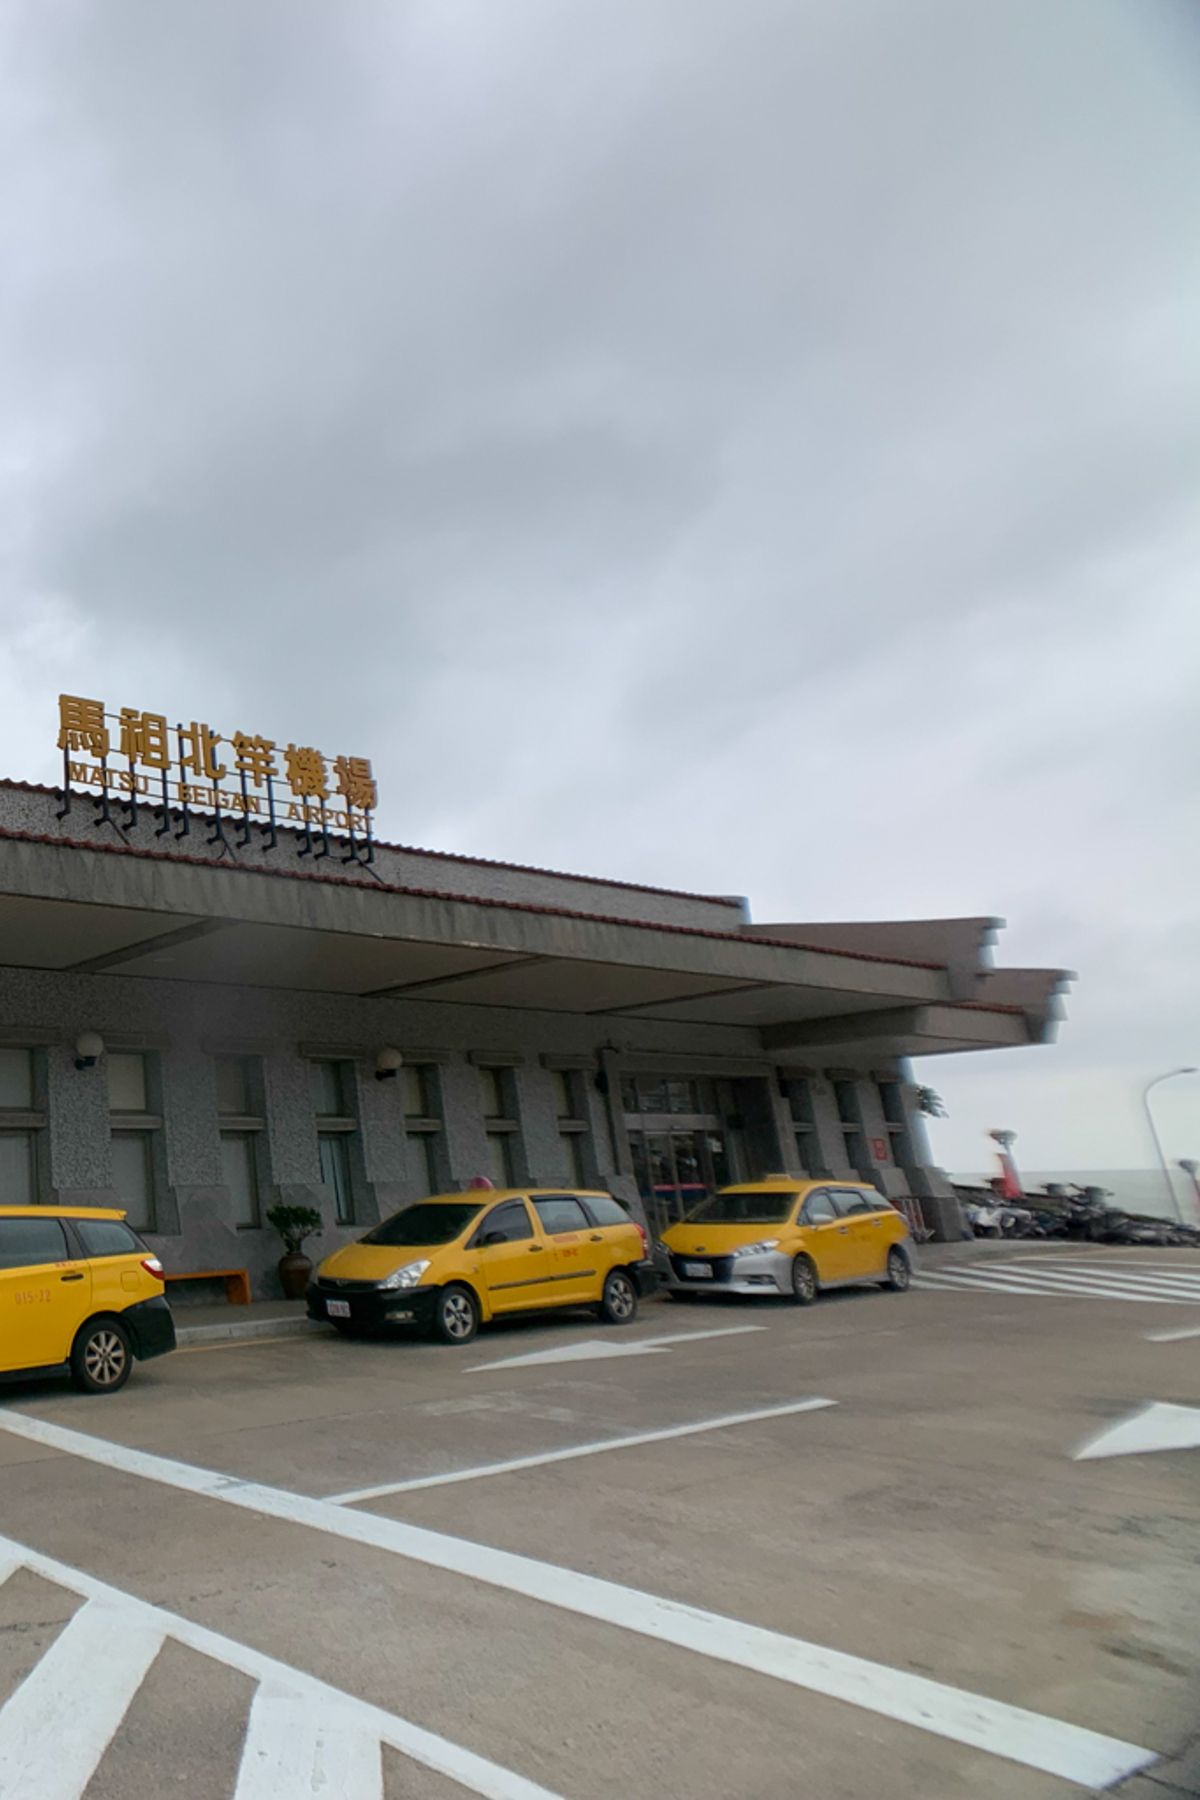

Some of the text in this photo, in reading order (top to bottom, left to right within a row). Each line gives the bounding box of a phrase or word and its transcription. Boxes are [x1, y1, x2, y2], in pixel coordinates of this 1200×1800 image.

[57, 693, 378, 810] 馬祖北竿機場
[69, 760, 375, 833] MATSU BEIGAN AIRPORT
